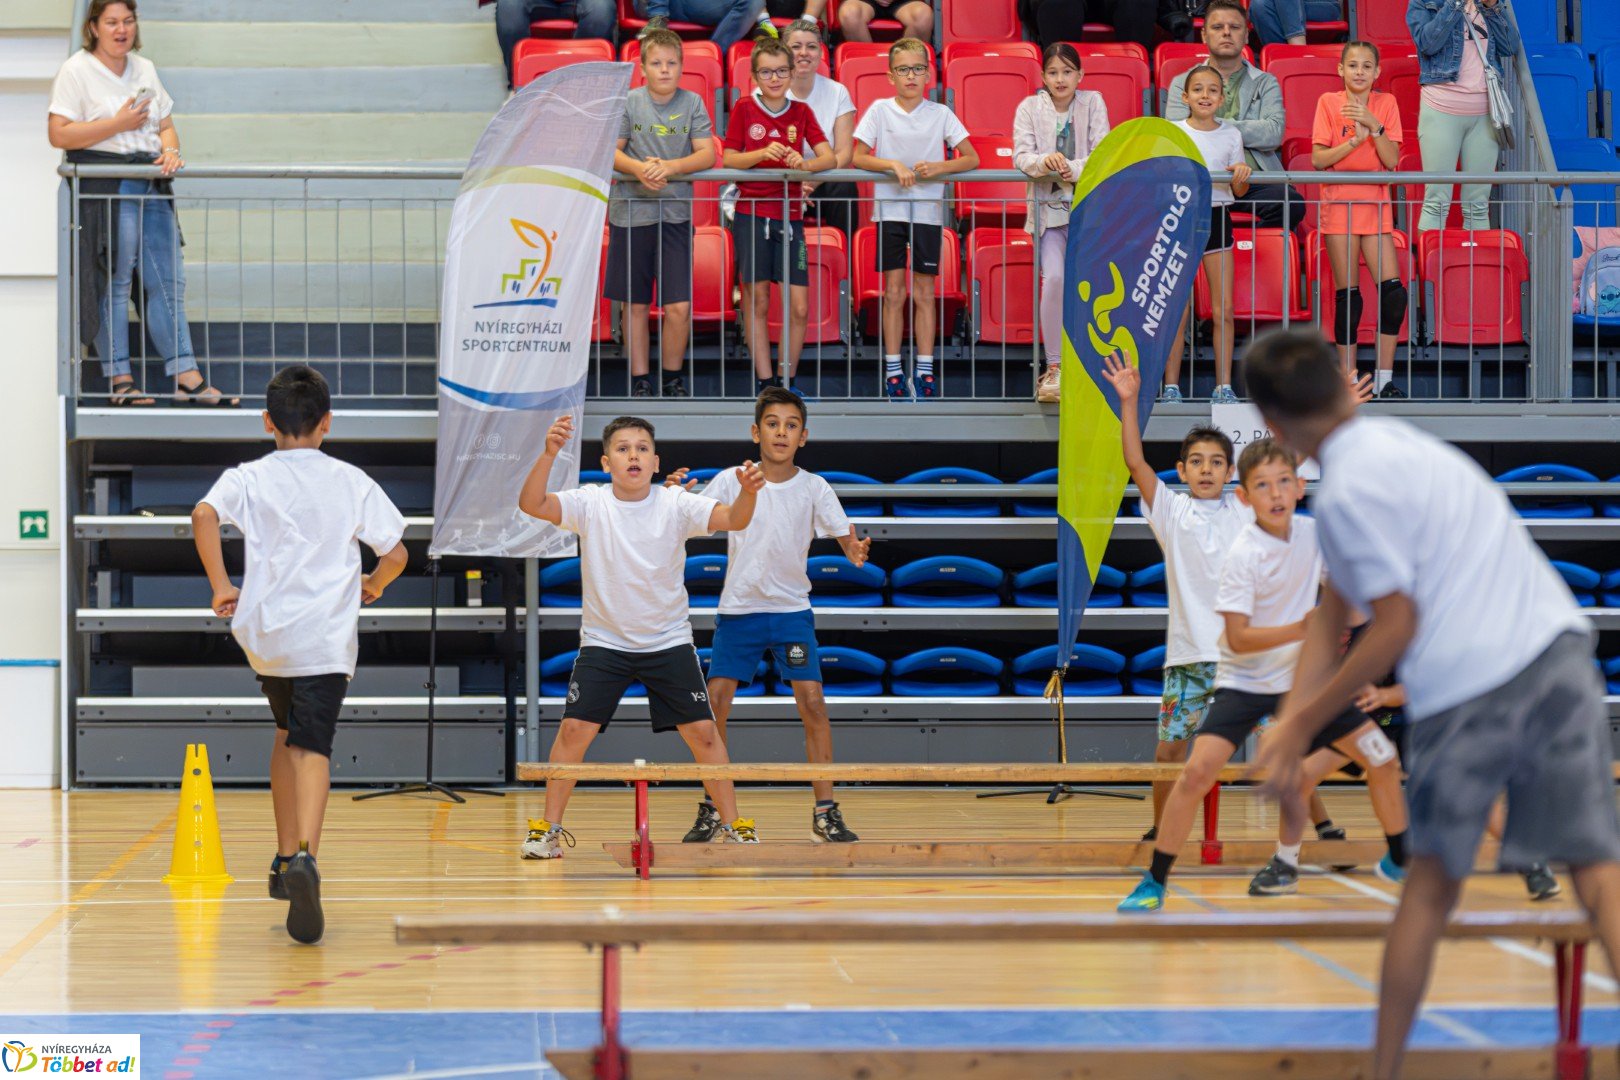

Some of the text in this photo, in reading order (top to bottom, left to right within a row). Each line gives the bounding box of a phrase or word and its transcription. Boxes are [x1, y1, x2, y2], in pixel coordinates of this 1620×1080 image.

[1131, 184, 1192, 308] SPORTOLÓ
[1142, 241, 1188, 338] NEMZET
[474, 319, 562, 334] NYÍREGYHÁZI
[462, 339, 571, 352] SPORTCENTRUM
[1232, 430, 1247, 445] 2.
